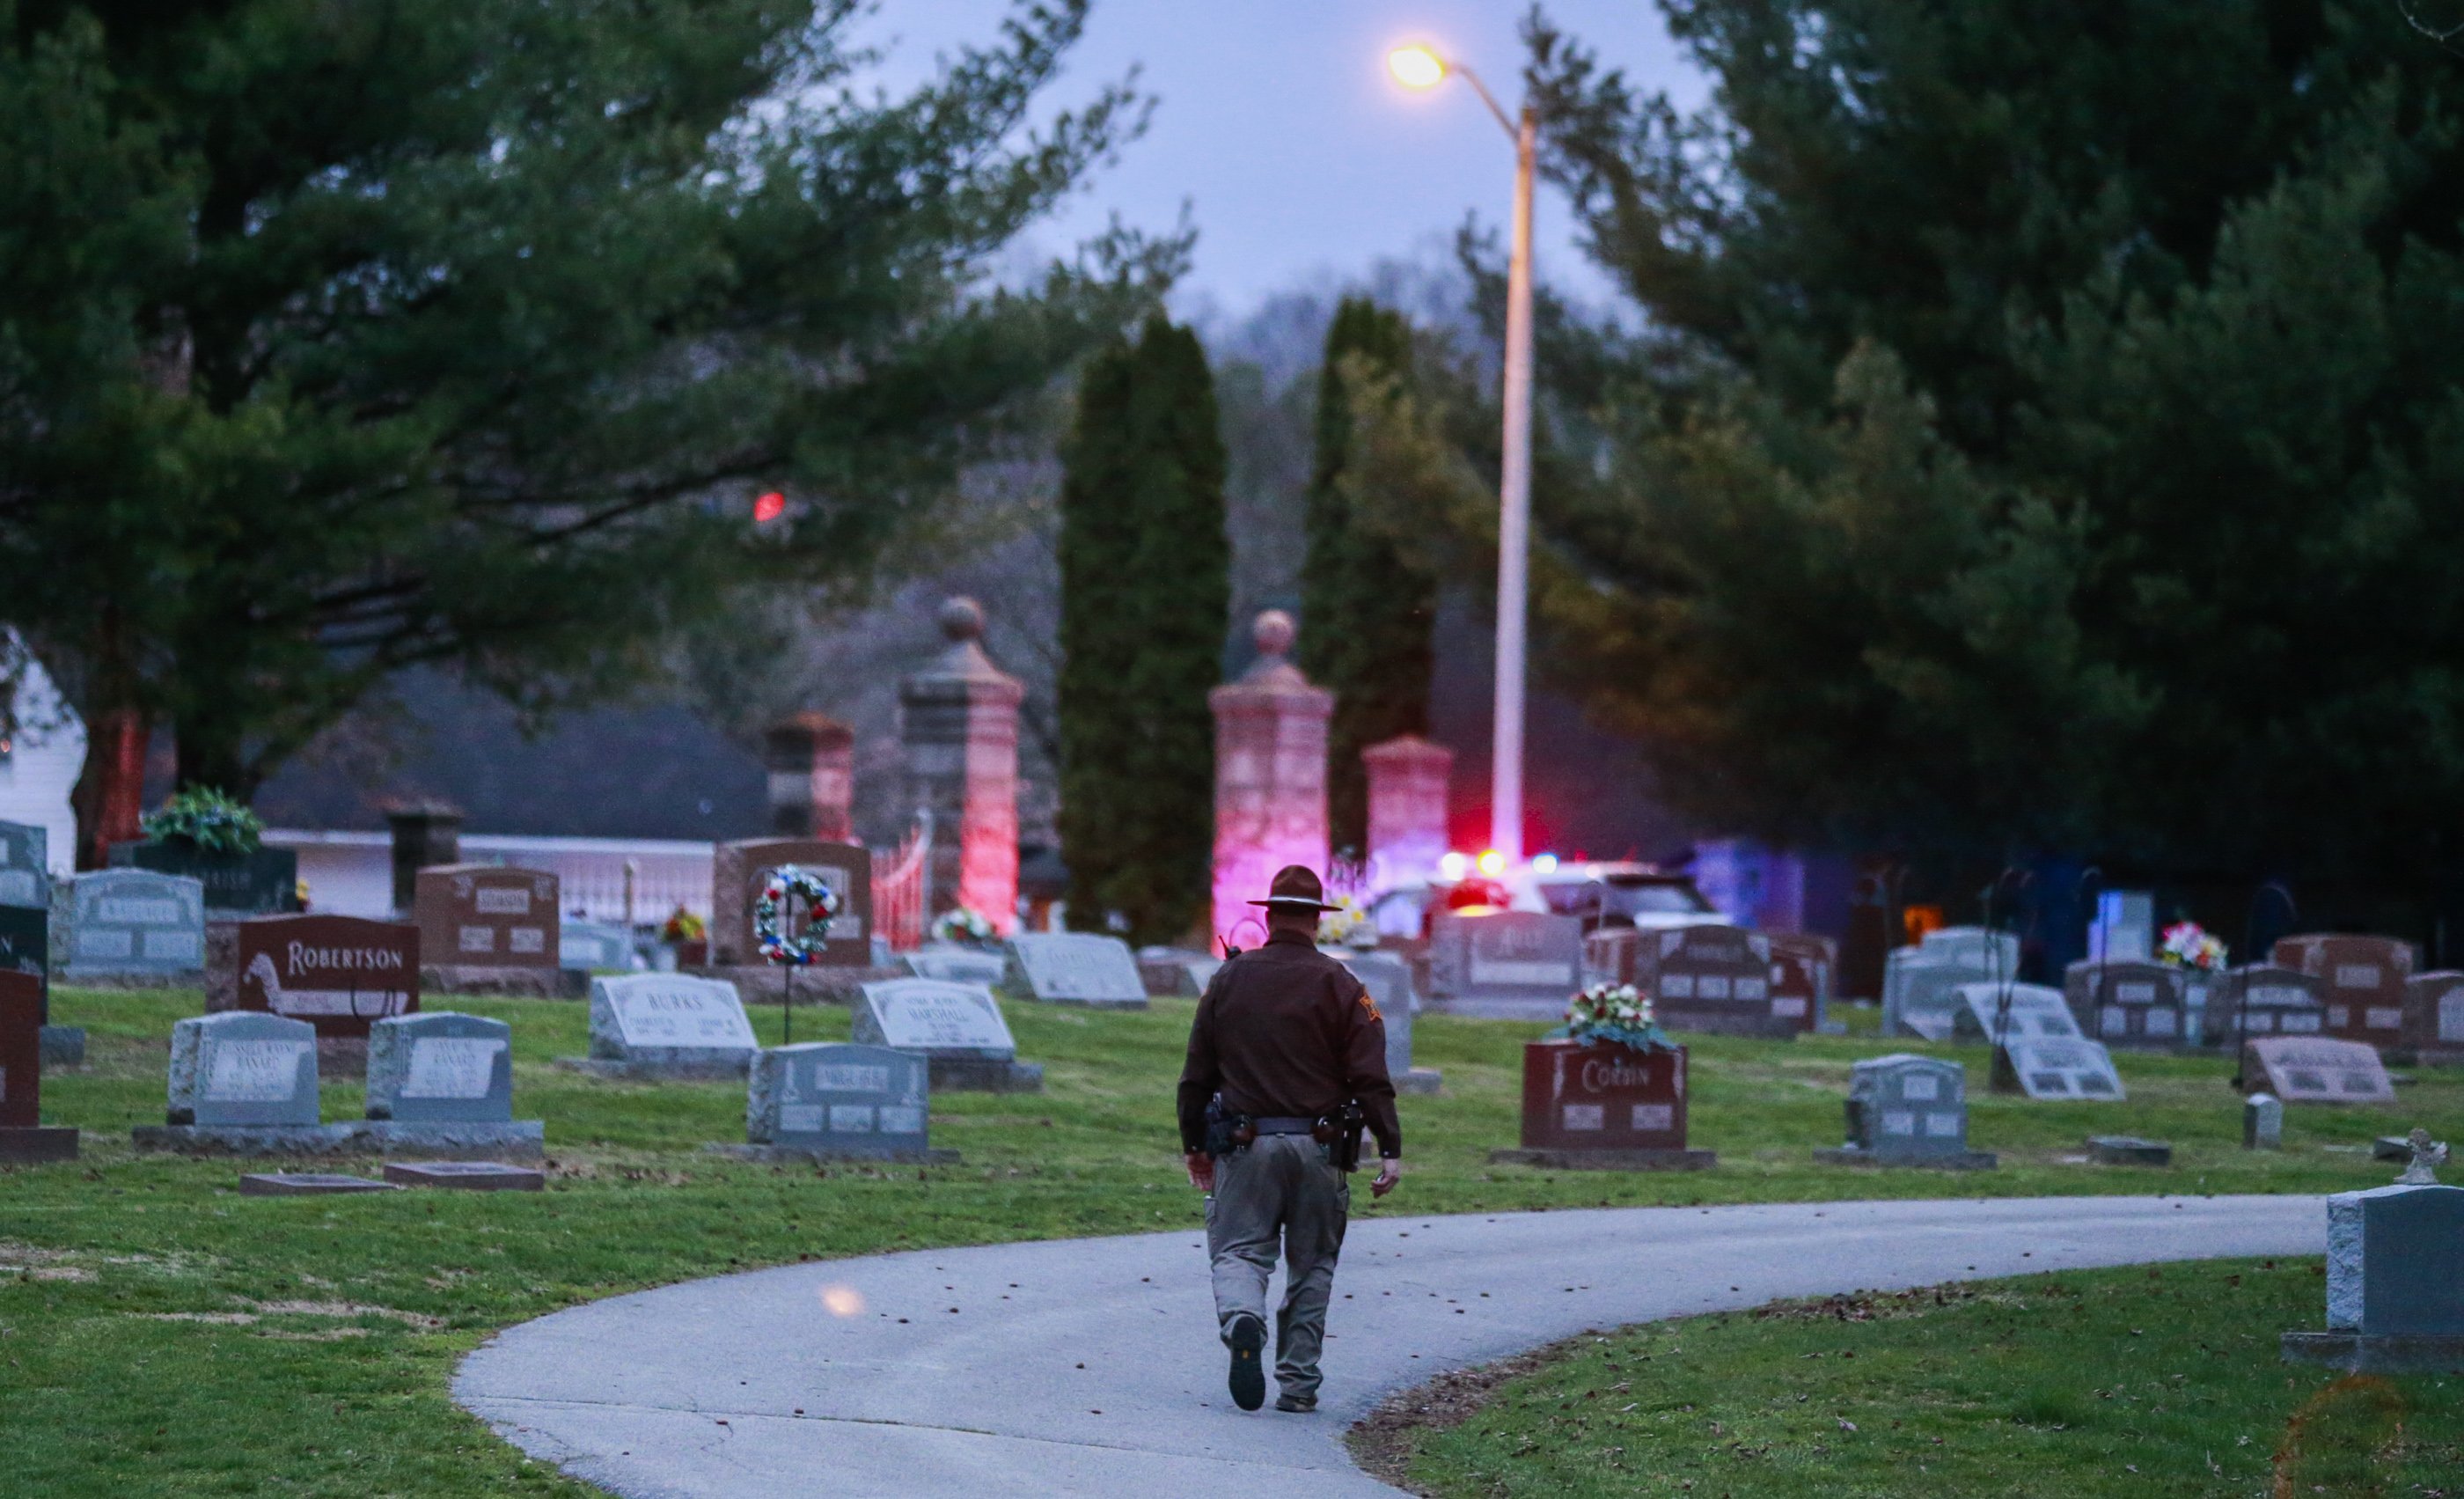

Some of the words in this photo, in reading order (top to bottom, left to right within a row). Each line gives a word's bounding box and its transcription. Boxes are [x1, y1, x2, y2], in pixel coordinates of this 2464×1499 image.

[287, 939, 403, 976] ROBERTSON
[646, 992, 703, 1010] BURKS
[906, 1008, 969, 1023] MARSHALL
